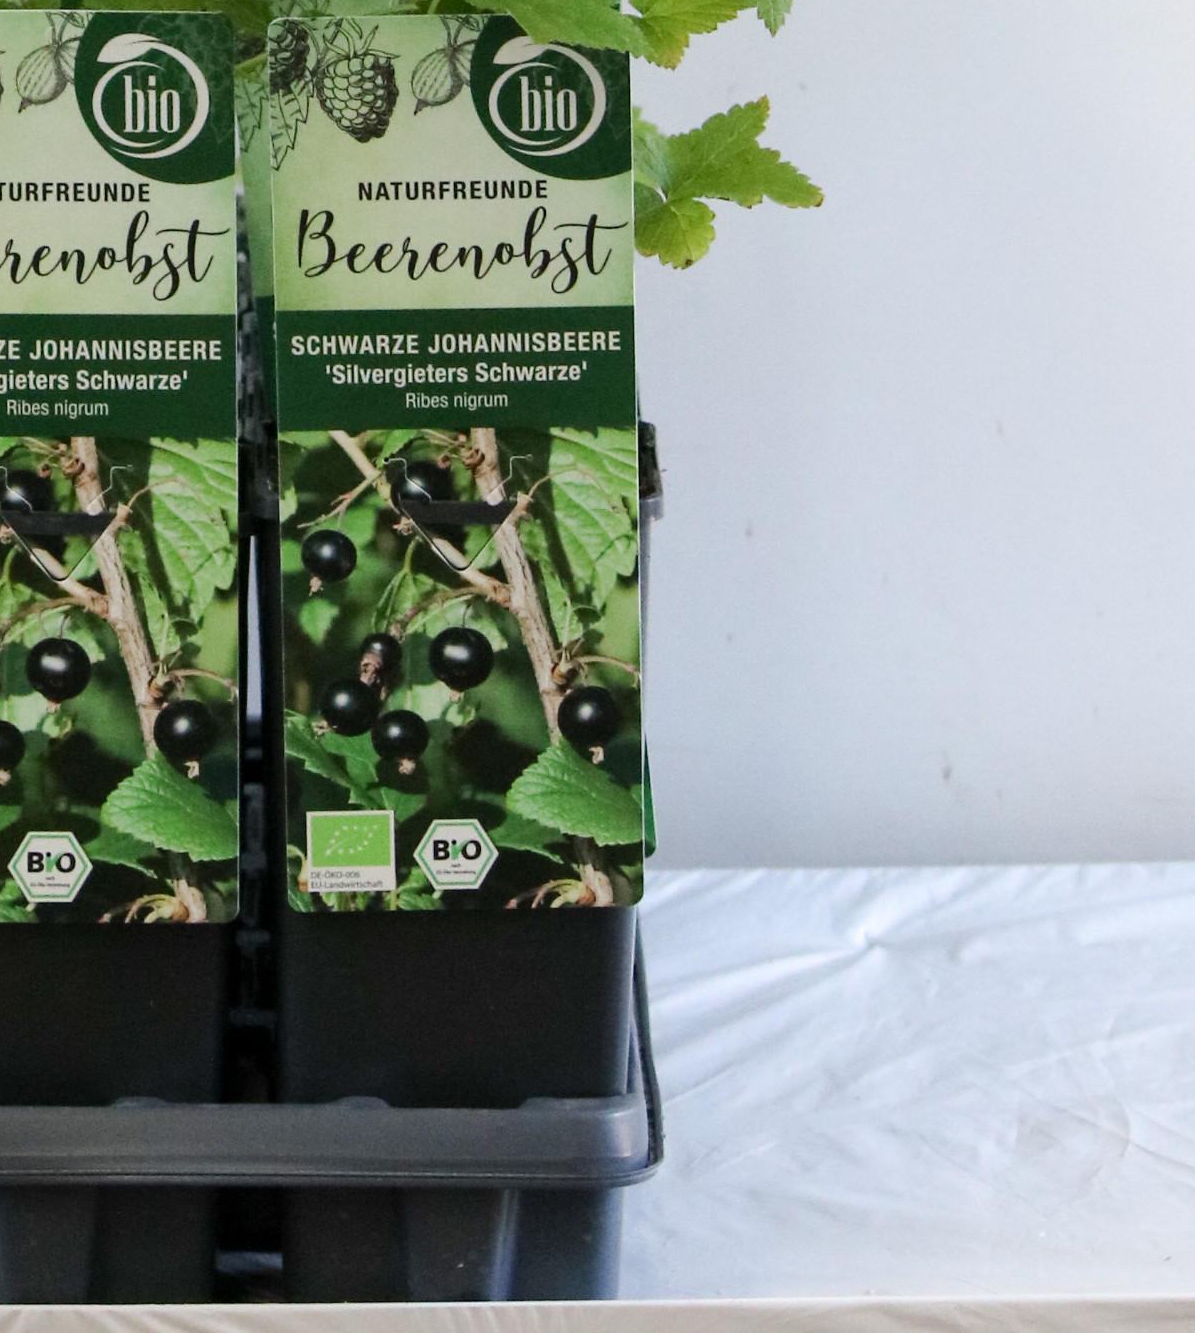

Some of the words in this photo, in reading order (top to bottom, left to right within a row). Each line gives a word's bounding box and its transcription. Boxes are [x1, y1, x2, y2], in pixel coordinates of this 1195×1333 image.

[123, 75, 180, 133] bio
[520, 75, 577, 132] bio
[358, 180, 548, 201] NATURFREUNDE
[298, 206, 628, 294] Beerenobst
[29, 339, 222, 361] JOHANNISBEERE
[291, 334, 418, 356] SCHWARZE
[428, 331, 621, 353] JOHANNISBEERE
[76, 370, 188, 391] Schwarze'
[326, 363, 468, 388] 'Silvergieters
[475, 361, 587, 383] Schwarze'
[6, 399, 49, 416] Ribes
[54, 399, 109, 420] nigrum
[405, 392, 447, 409] Ribes
[453, 391, 508, 412] nigrum
[311, 881, 383, 889] EU-Landwirtschaft
